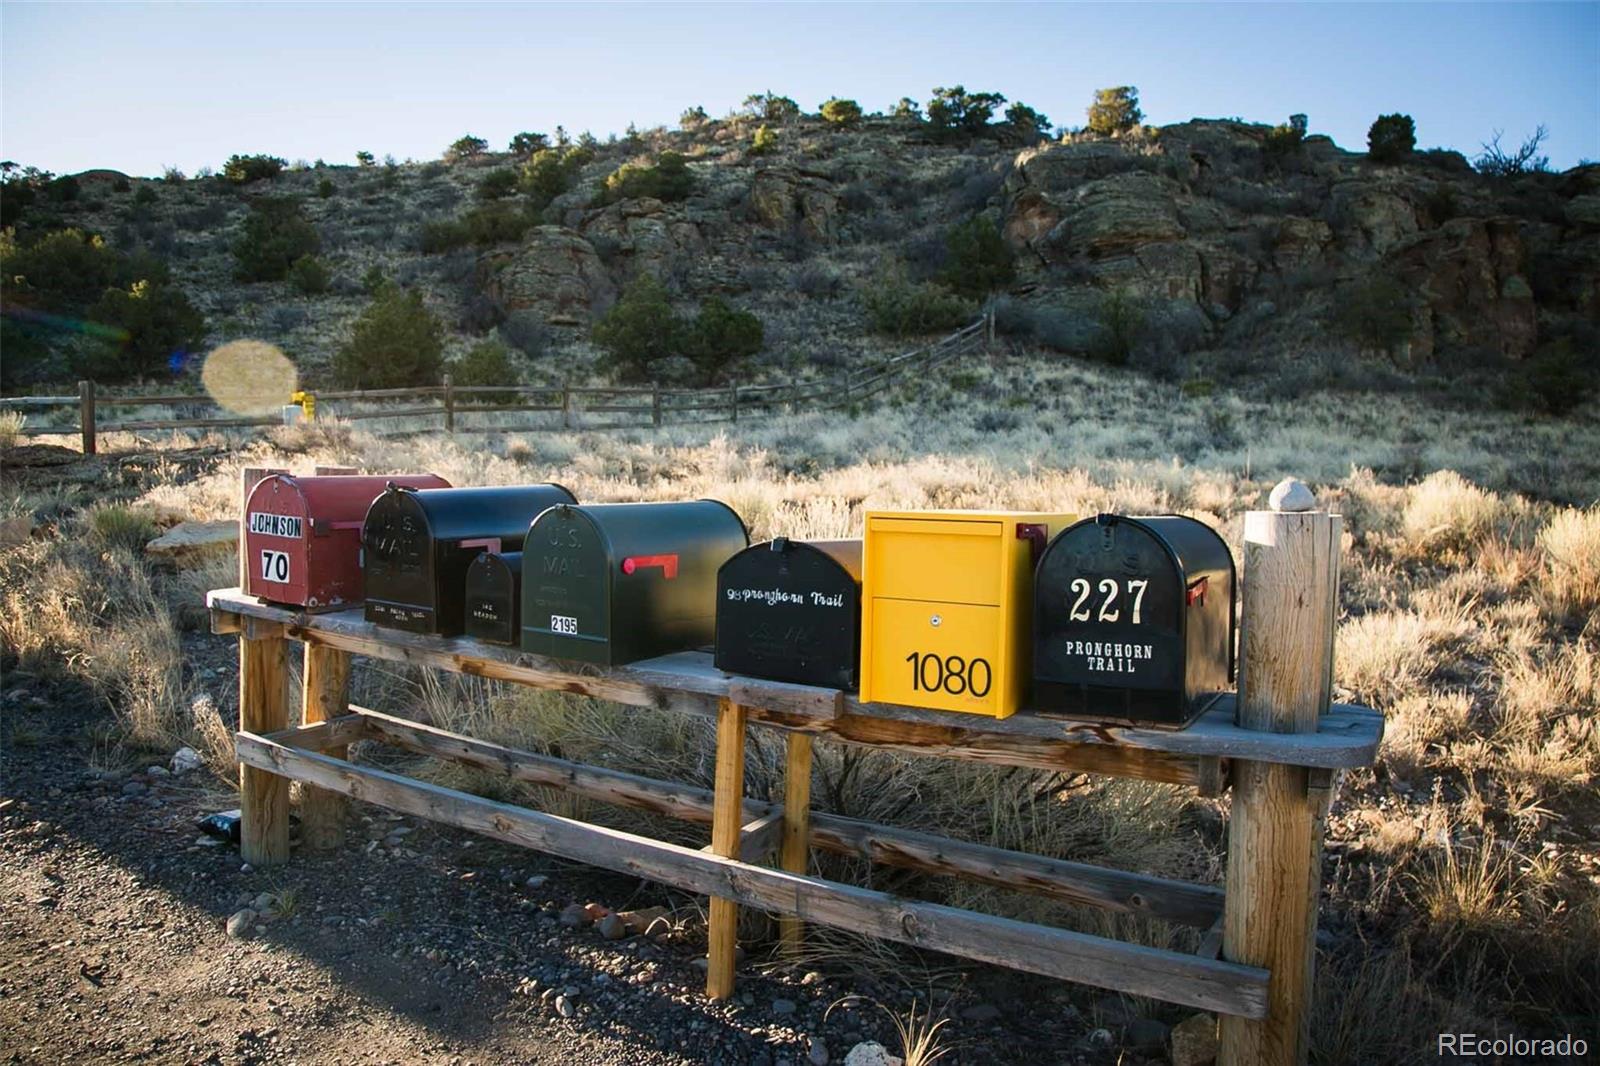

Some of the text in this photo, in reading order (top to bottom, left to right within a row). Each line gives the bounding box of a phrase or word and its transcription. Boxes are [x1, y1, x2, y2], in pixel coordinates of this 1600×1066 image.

[252, 514, 301, 537] JOHNSON
[263, 551, 288, 581] 70
[810, 591, 844, 607] Trail
[1069, 578, 1148, 624] 227
[552, 617, 577, 634] 2195
[1065, 641, 1153, 660] PRONGHORN
[906, 651, 992, 698] 1080
[1087, 656, 1136, 673] TRAIL
